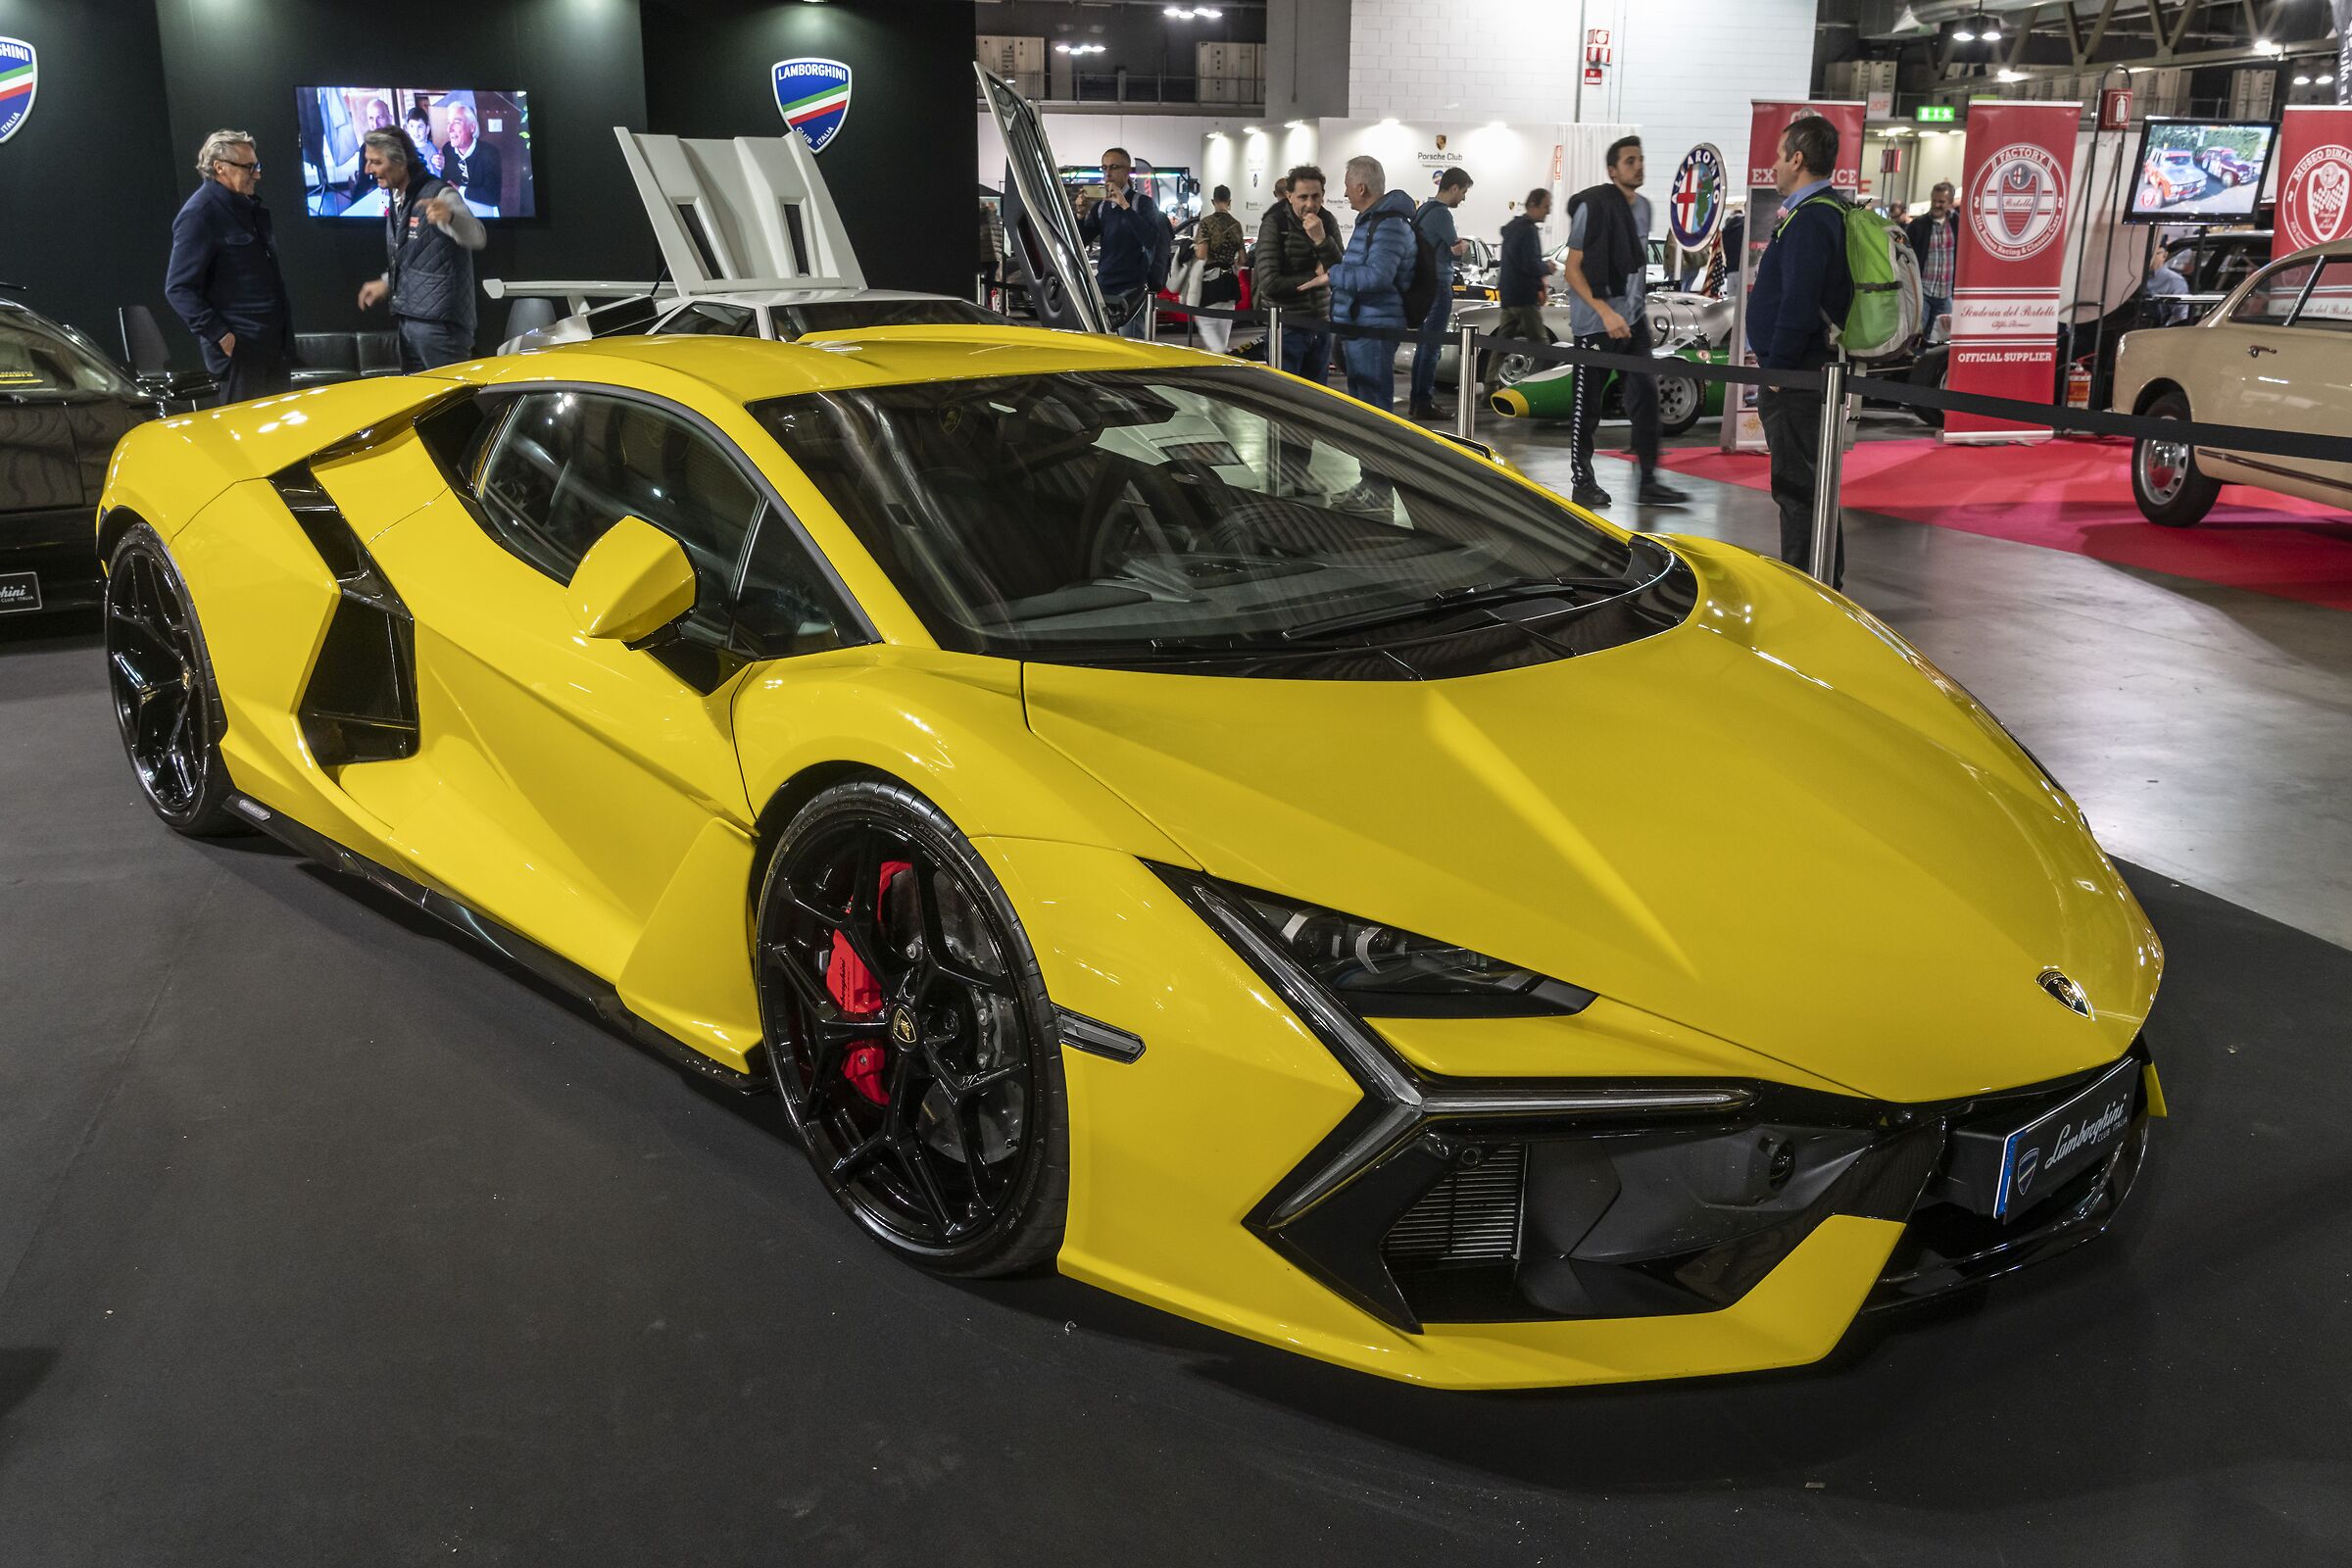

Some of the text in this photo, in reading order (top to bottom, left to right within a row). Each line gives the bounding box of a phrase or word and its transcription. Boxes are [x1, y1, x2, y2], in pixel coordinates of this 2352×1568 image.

[777, 64, 847, 81] LAMBORGHINI
[1, 112, 21, 133] ITALIA
[815, 126, 835, 146] ITALIA
[1998, 148, 2046, 163] FACTORY
[2293, 150, 2325, 182] MUSEO
[1997, 246, 2021, 256] Racing
[2003, 306, 2019, 318] del
[1958, 353, 2053, 363] OFFICIAL SUPPLIER
[2044, 1093, 2128, 1170] Lamborghini
[2097, 1127, 2111, 1143] CLUB
